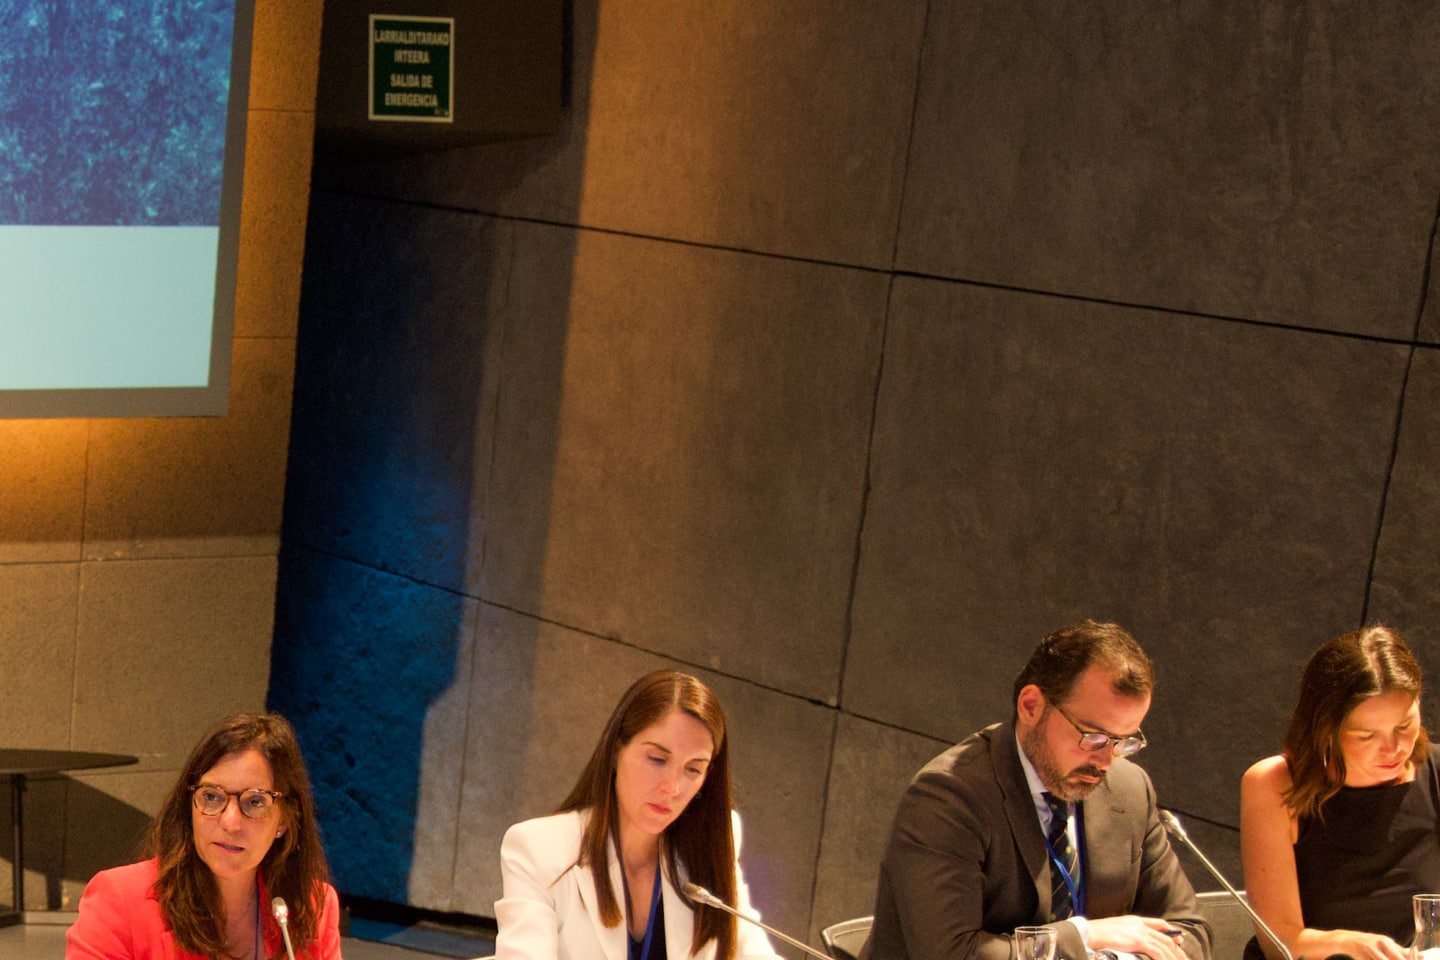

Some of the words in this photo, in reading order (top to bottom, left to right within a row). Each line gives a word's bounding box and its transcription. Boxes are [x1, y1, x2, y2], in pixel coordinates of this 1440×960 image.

[390, 73, 419, 88] SALIDA
[421, 74, 433, 88] DE
[384, 92, 438, 107] EMERGENCIA
